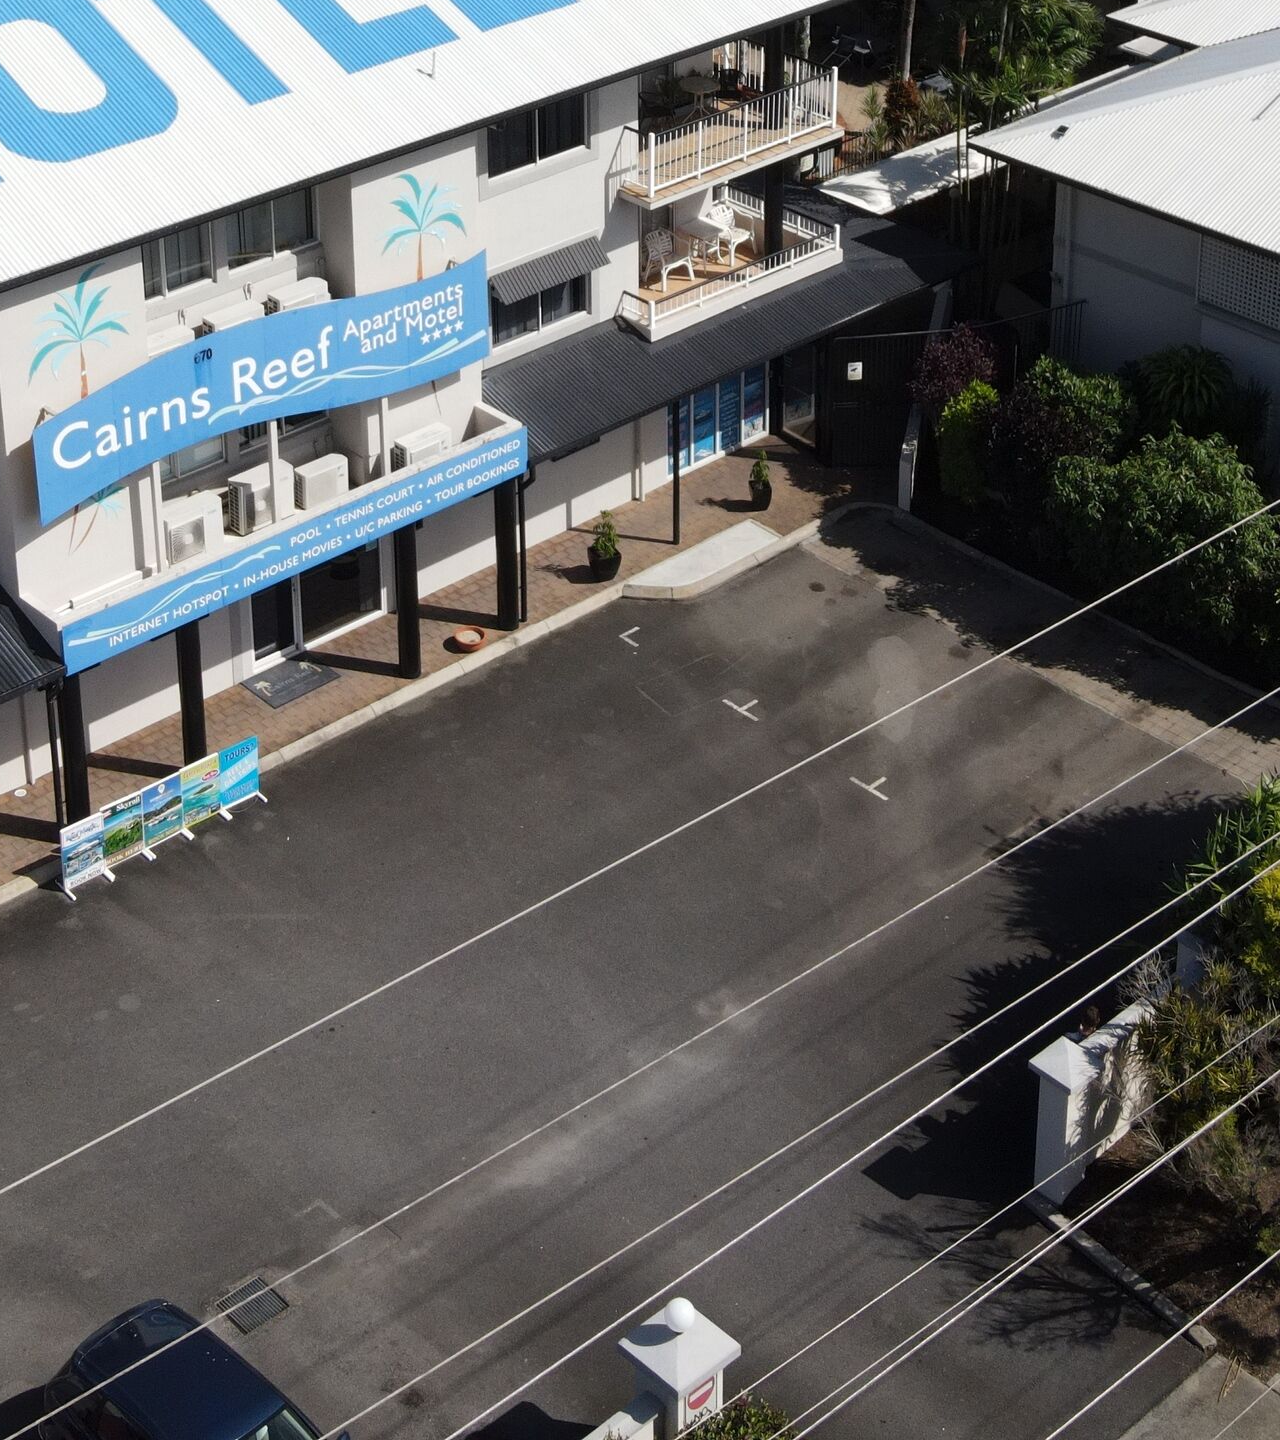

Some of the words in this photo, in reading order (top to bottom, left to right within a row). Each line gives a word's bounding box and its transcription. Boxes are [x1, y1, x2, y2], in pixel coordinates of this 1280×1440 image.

[343, 283, 463, 342] Apartments
[360, 326, 400, 354] and
[405, 296, 463, 337] Motel
[194, 348, 213, 364] 670
[52, 386, 210, 469] Cairns
[231, 325, 334, 403] Reef
[290, 526, 322, 547] POOL
[334, 501, 372, 527] TENNIS
[376, 485, 415, 508] COURT
[426, 472, 444, 488] AIR
[445, 439, 521, 479] CONDITIONED
[108, 611, 170, 647] INTERNET
[173, 585, 229, 619] HOTSPOT
[243, 555, 299, 588] IN-HOUSE
[302, 536, 343, 562] MOVIES
[355, 522, 375, 538] U/C
[377, 500, 424, 528] PARKING
[435, 482, 465, 502] TOUR
[467, 458, 520, 489] BOOKINGS
[224, 742, 255, 762] TOURS?
